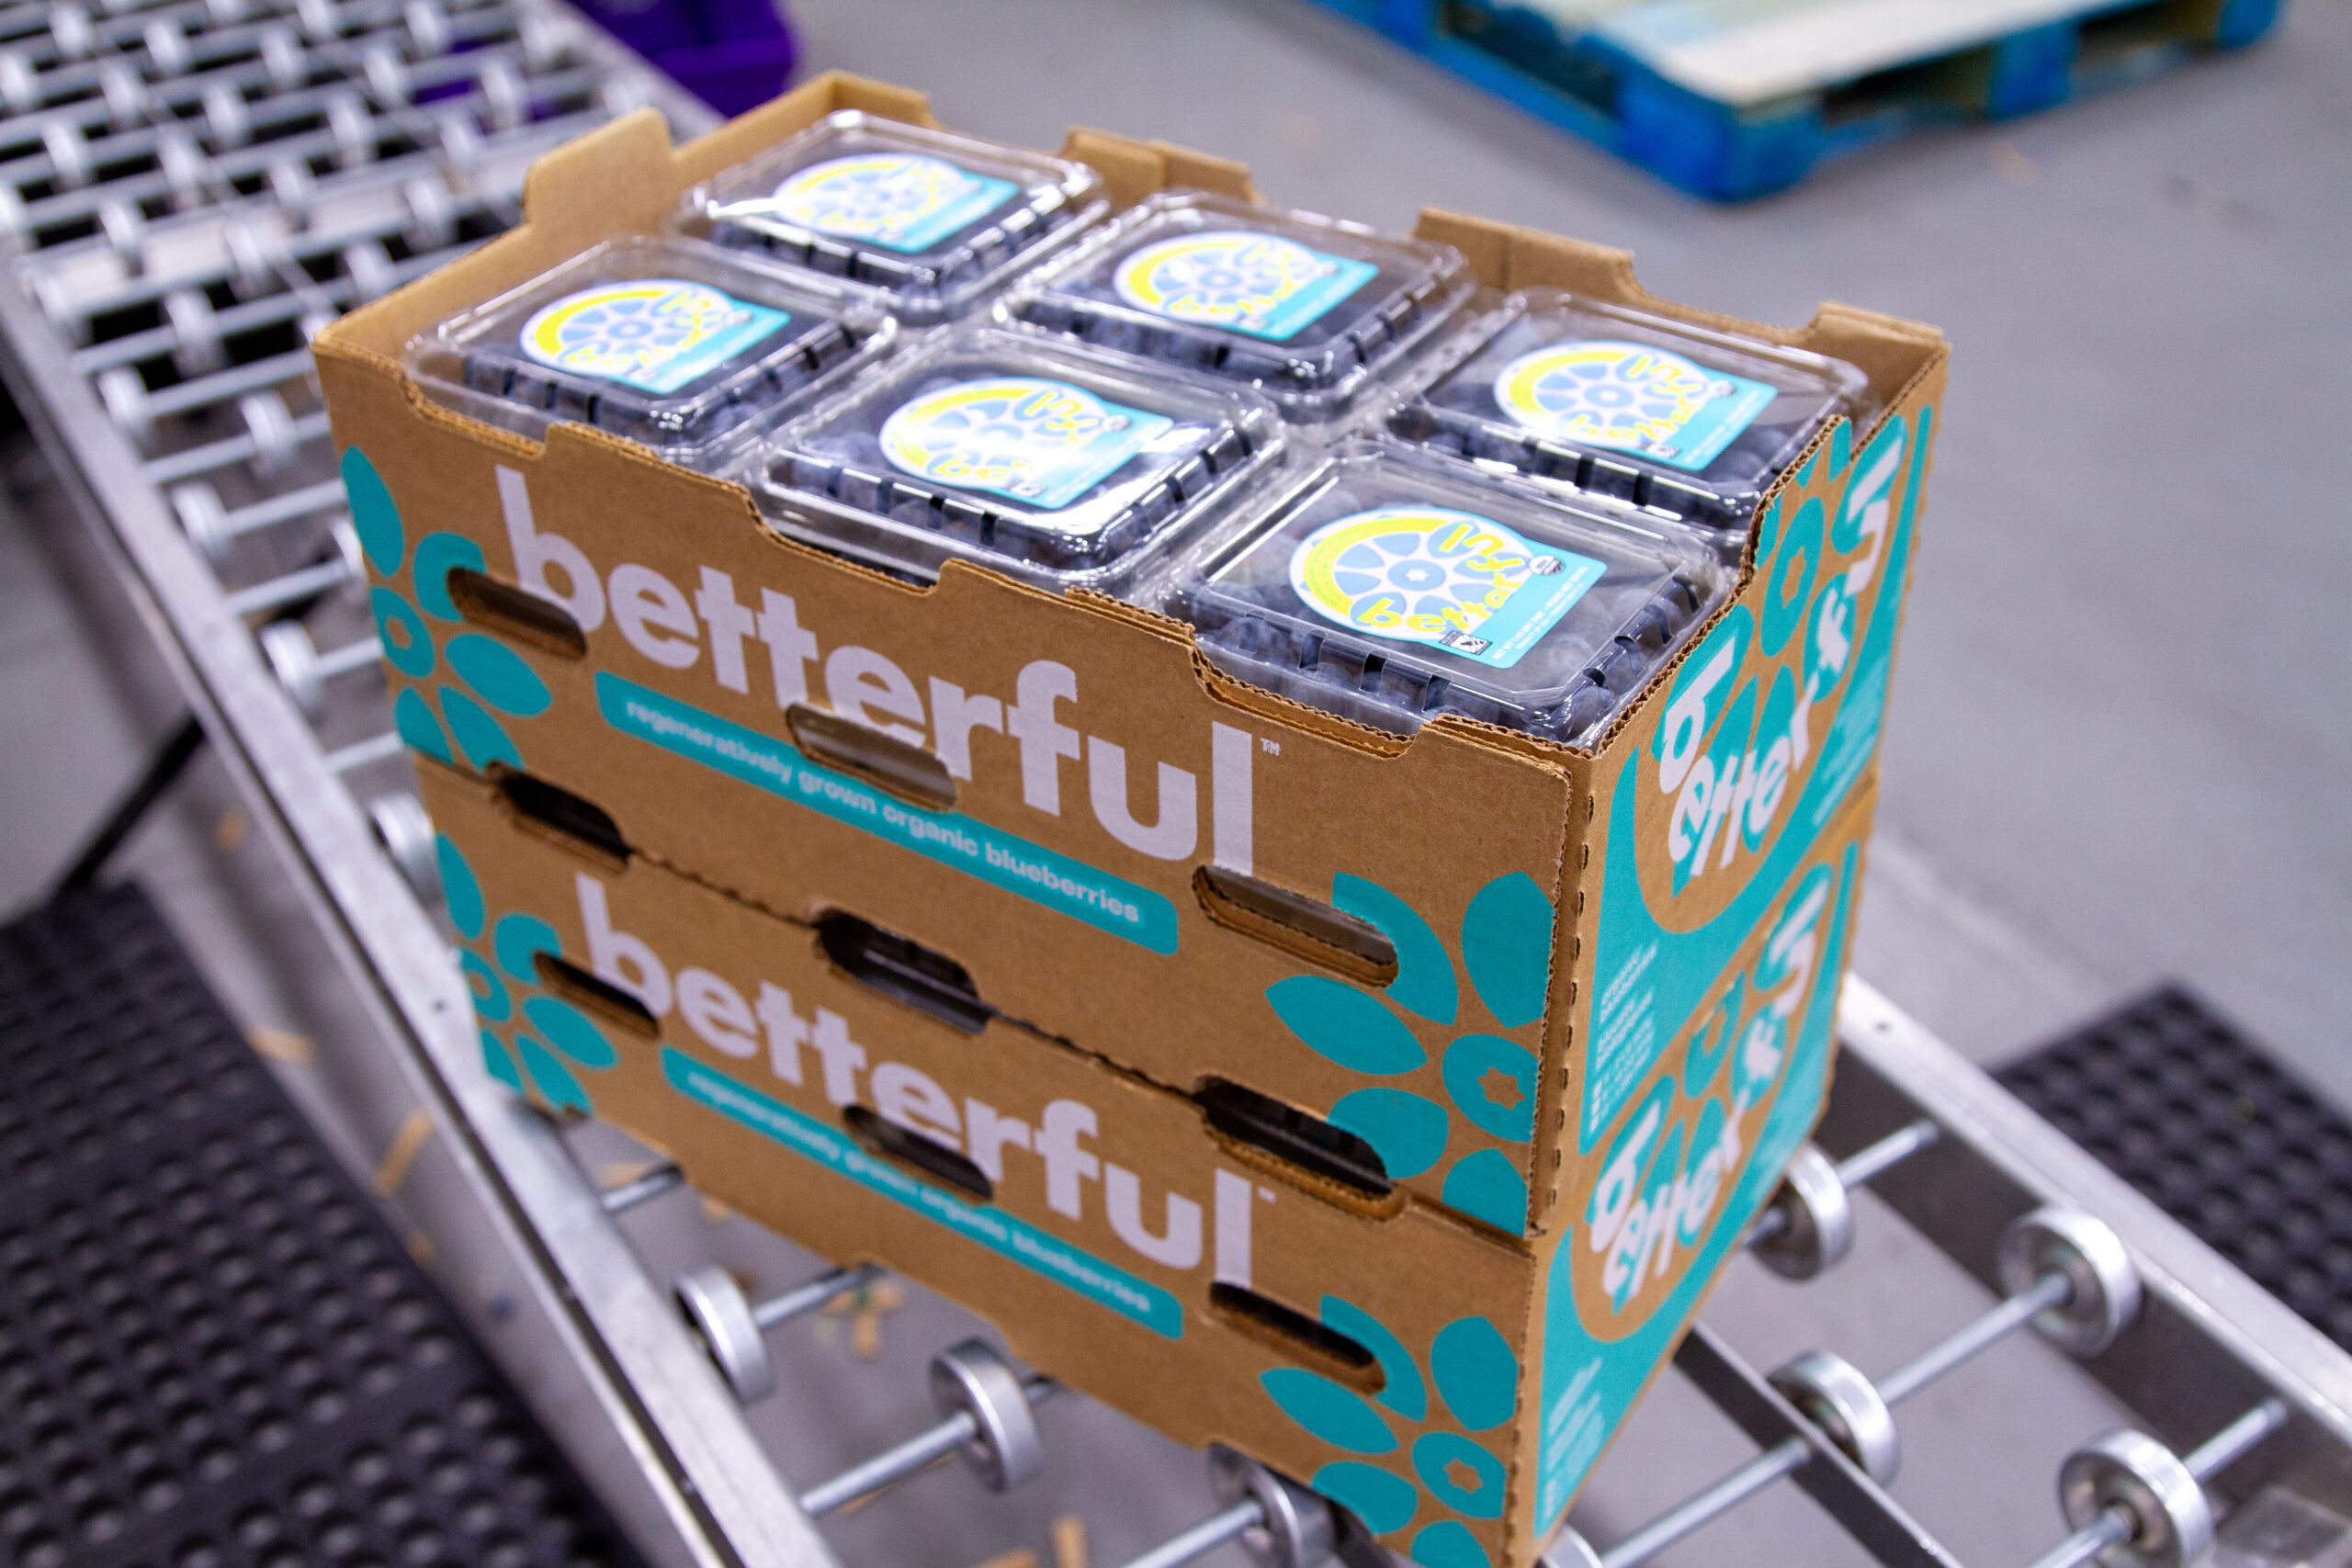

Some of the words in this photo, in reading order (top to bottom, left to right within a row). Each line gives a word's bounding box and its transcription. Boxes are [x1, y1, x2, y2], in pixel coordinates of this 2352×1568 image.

[495, 463, 1252, 876] betterful
[797, 770, 877, 815] grown
[882, 802, 979, 857] organic
[984, 841, 1140, 923] blueberries
[576, 872, 1252, 1290] betterful
